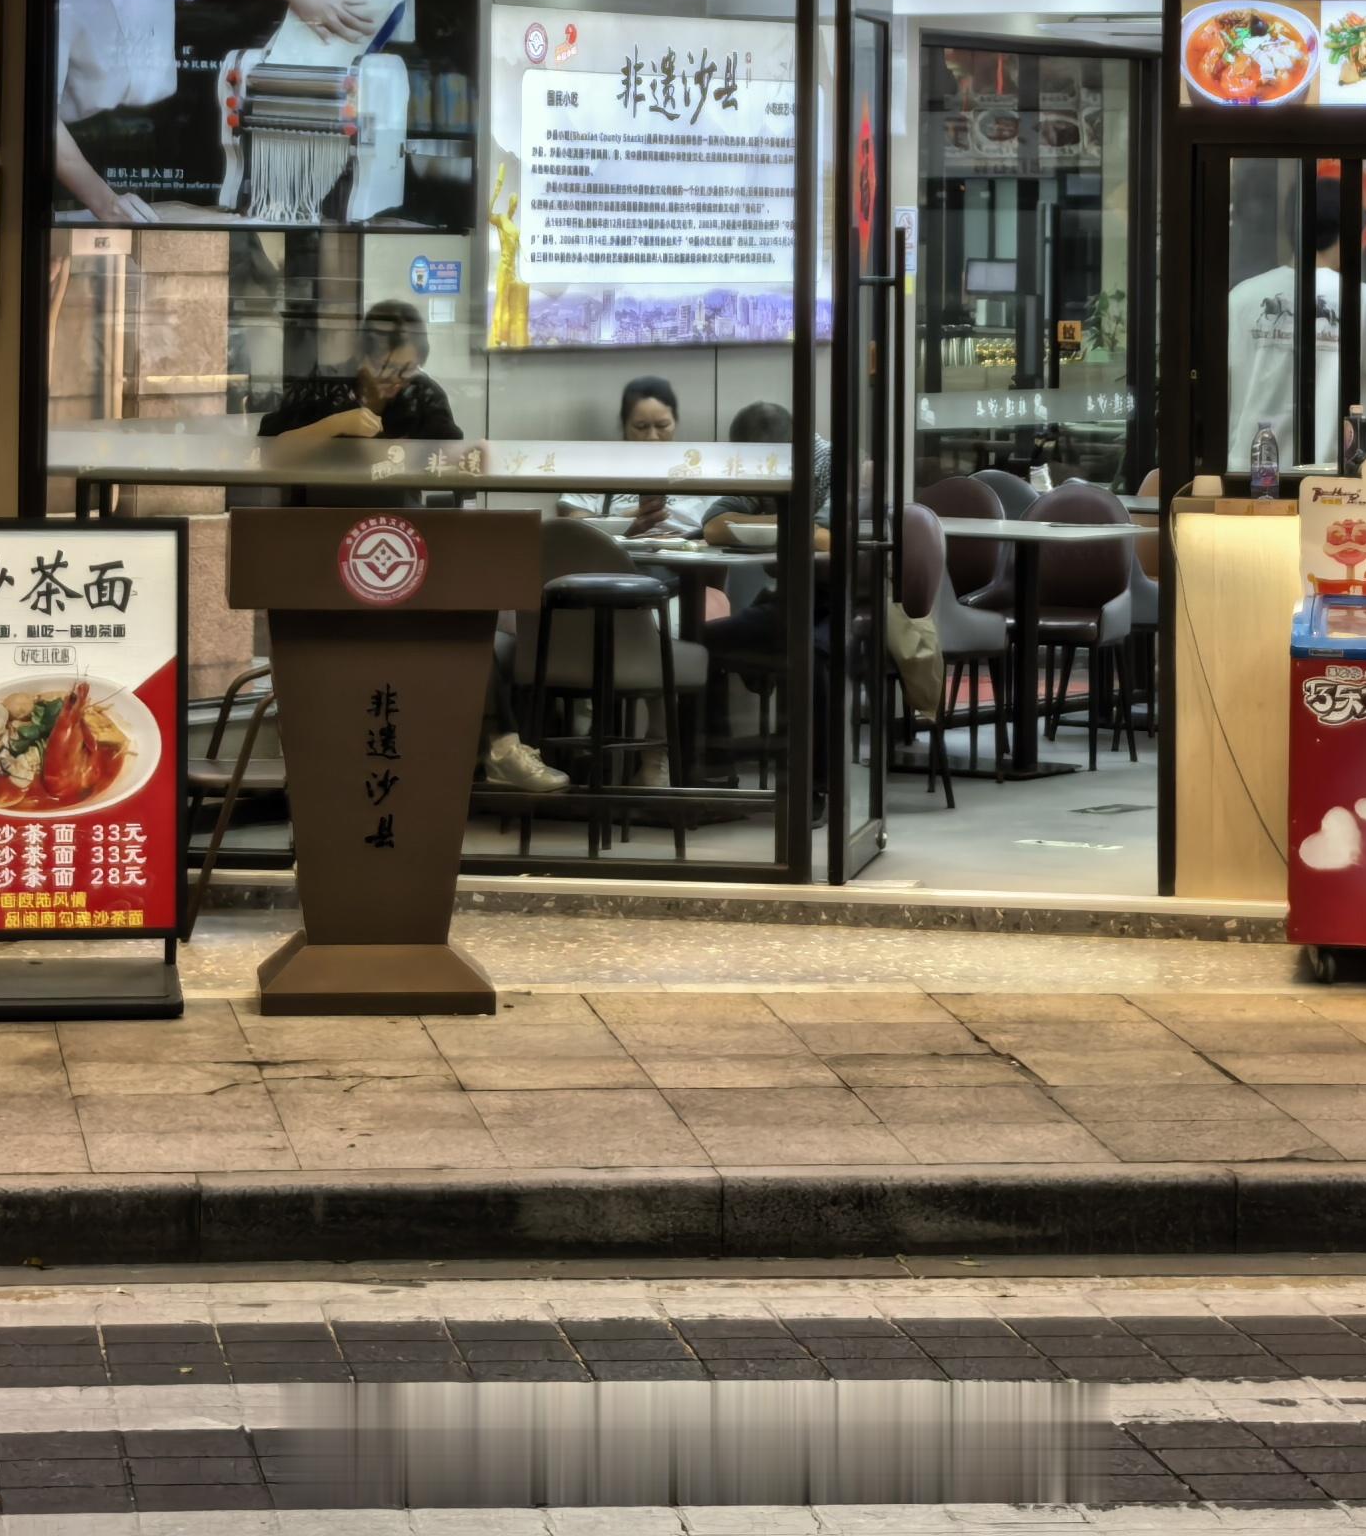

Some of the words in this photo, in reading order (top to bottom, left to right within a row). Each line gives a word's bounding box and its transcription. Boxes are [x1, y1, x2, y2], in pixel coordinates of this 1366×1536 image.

[616, 43, 739, 126] 非遗沙县
[363, 682, 401, 849] 非遗沙县
[91, 823, 148, 843] 33元
[90, 845, 147, 864] 33元
[90, 866, 147, 886] 28元
